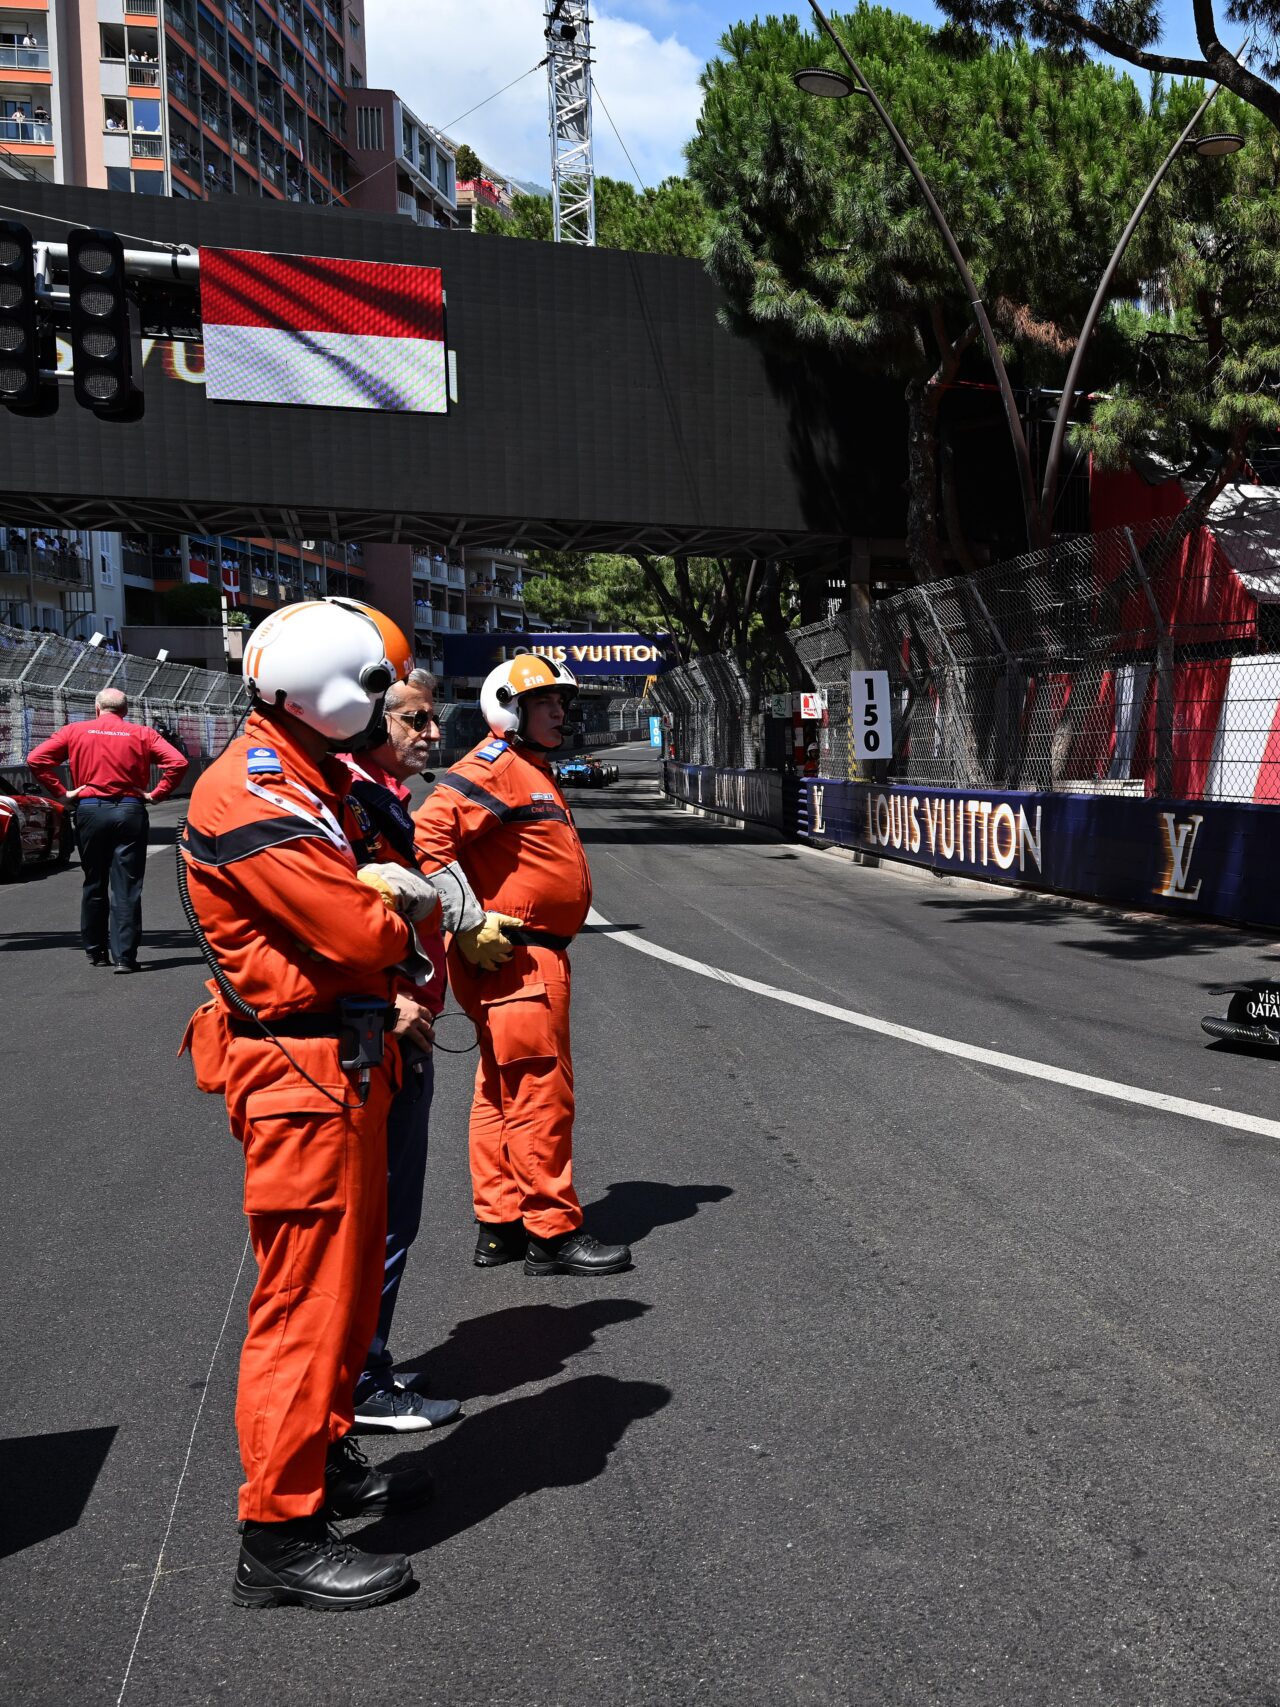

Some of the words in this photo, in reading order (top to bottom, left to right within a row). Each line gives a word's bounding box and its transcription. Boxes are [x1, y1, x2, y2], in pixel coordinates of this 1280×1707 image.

[575, 644, 667, 662] VUITTON
[864, 678, 880, 752] 150
[867, 792, 921, 854] LOUIS
[925, 797, 1042, 875] VUITTON
